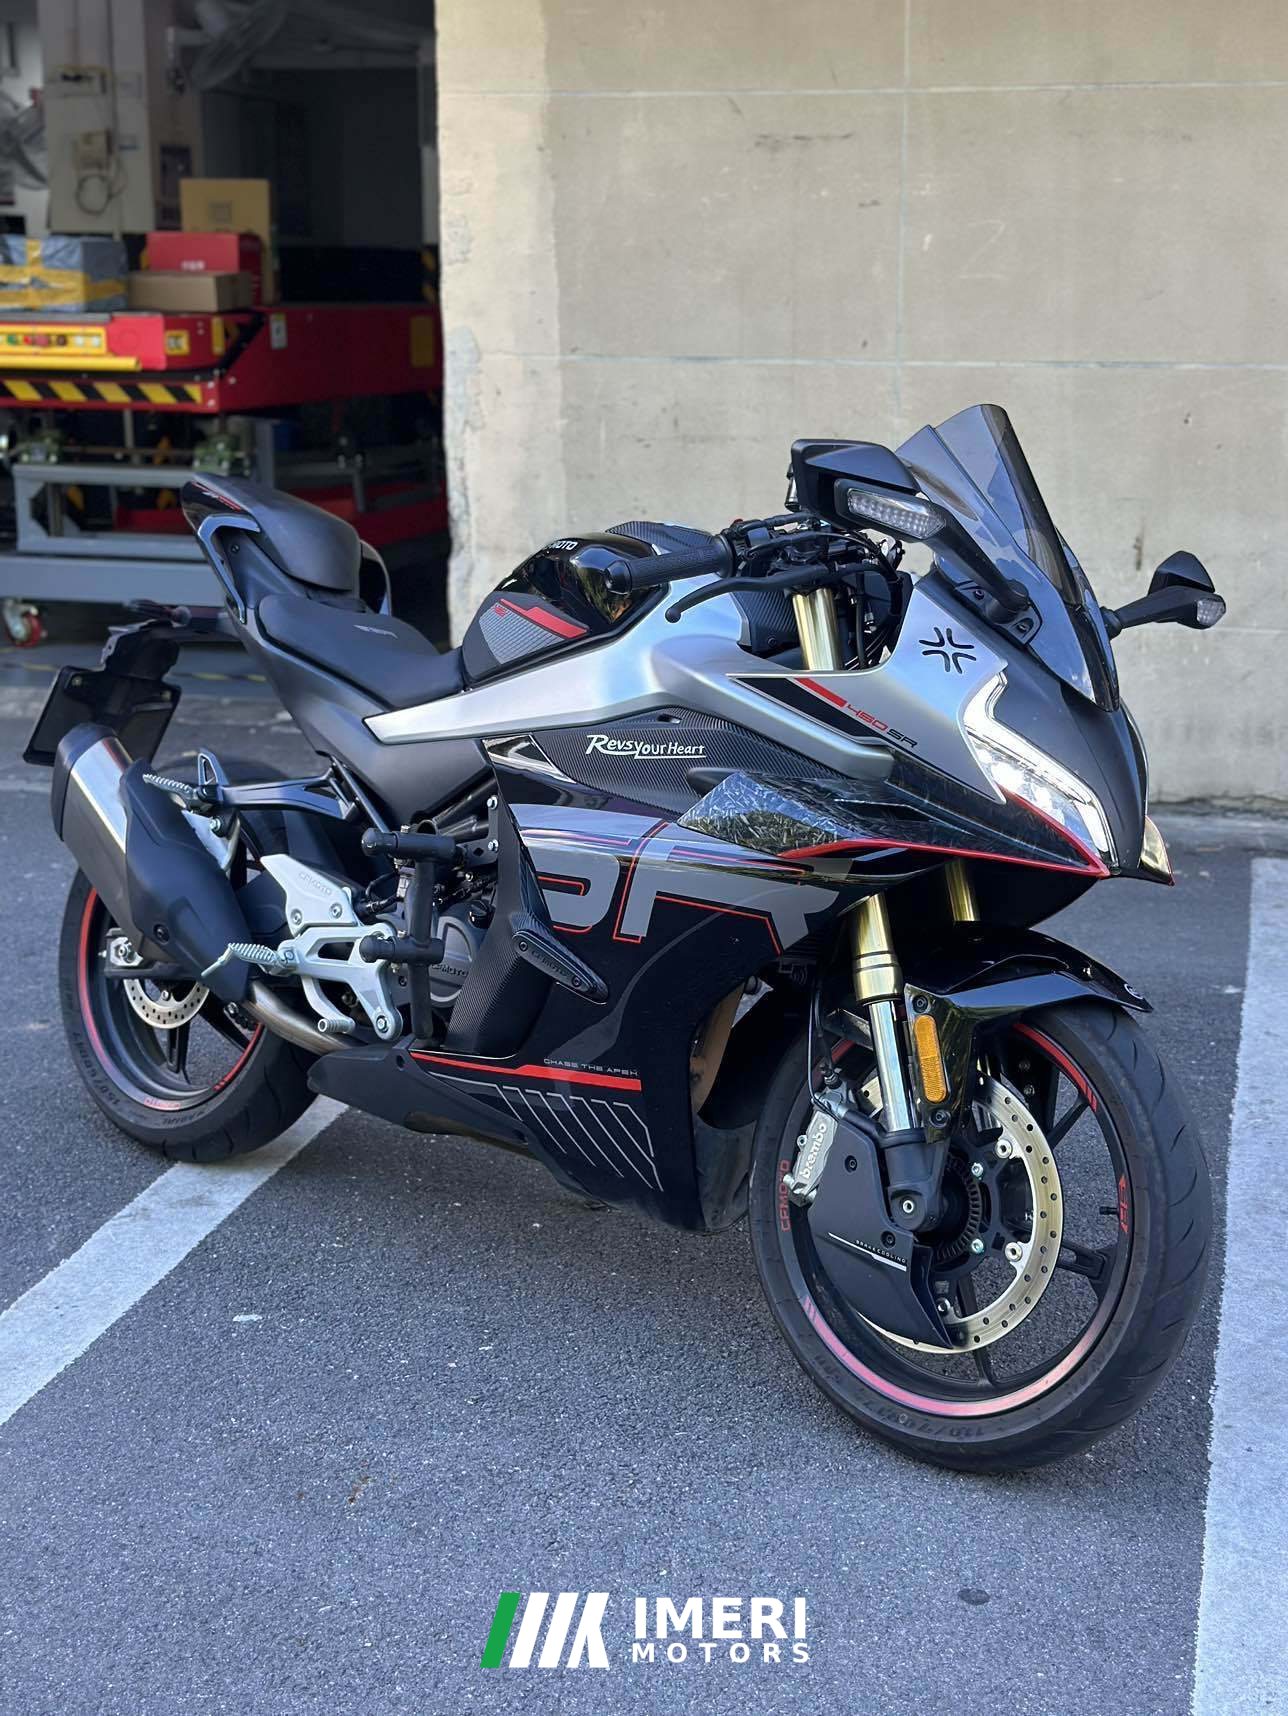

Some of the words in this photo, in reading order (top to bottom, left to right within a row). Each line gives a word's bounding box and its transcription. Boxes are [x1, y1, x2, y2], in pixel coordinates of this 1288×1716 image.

[543, 1058, 579, 1069] CHASE
[581, 1062, 604, 1072] THE
[800, 1122, 827, 1181] brembo
[778, 1158, 792, 1233] CFMOO
